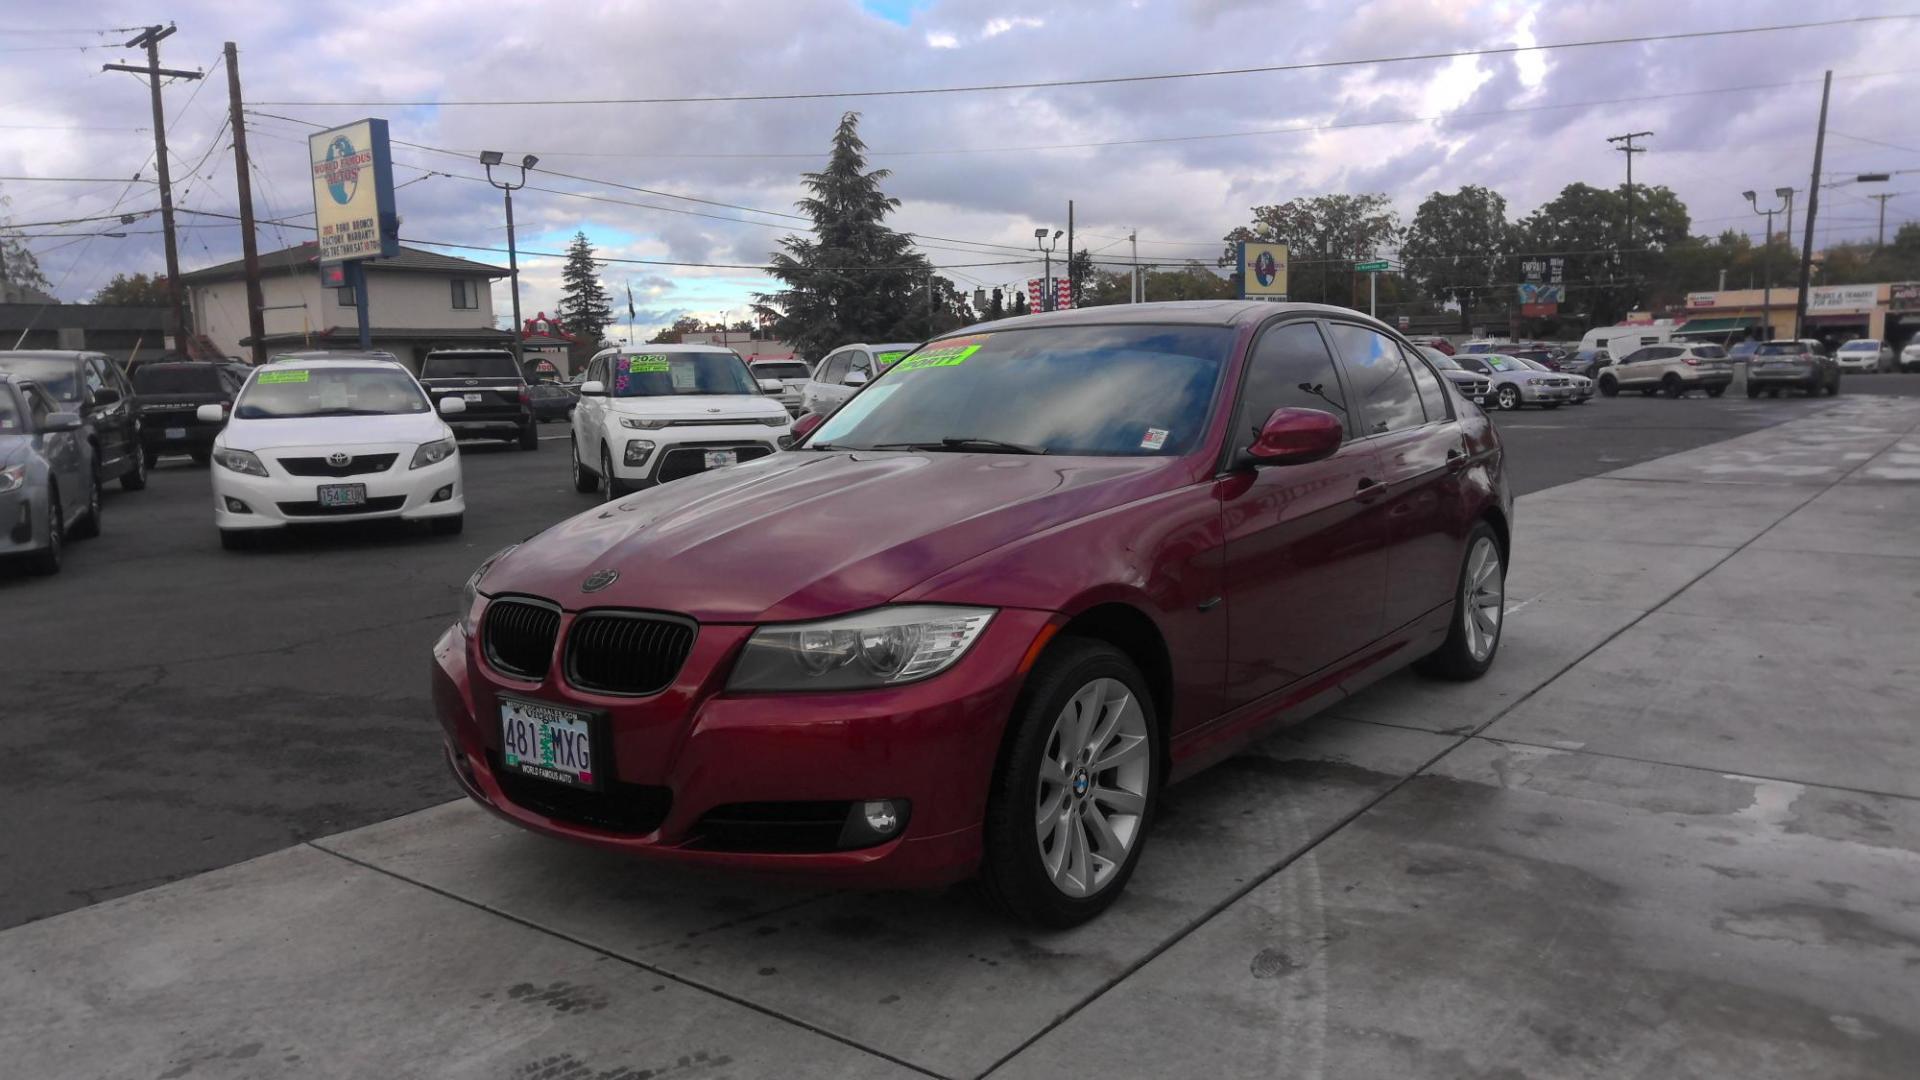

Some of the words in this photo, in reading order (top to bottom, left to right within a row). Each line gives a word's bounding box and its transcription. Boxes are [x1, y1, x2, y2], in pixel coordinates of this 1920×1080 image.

[313, 160, 339, 175] WORLD
[339, 151, 372, 168] FAMOUS
[352, 217, 374, 231] BRONCO
[321, 232, 344, 247] FACTORY
[346, 229, 375, 242] WARRANTY
[631, 353, 666, 362] 2020
[505, 717, 537, 759] 481
[550, 726, 590, 770] MXG
[521, 765, 539, 776] WORLD
[538, 768, 559, 781] FAMOUS
[559, 772, 572, 784] AUTO
